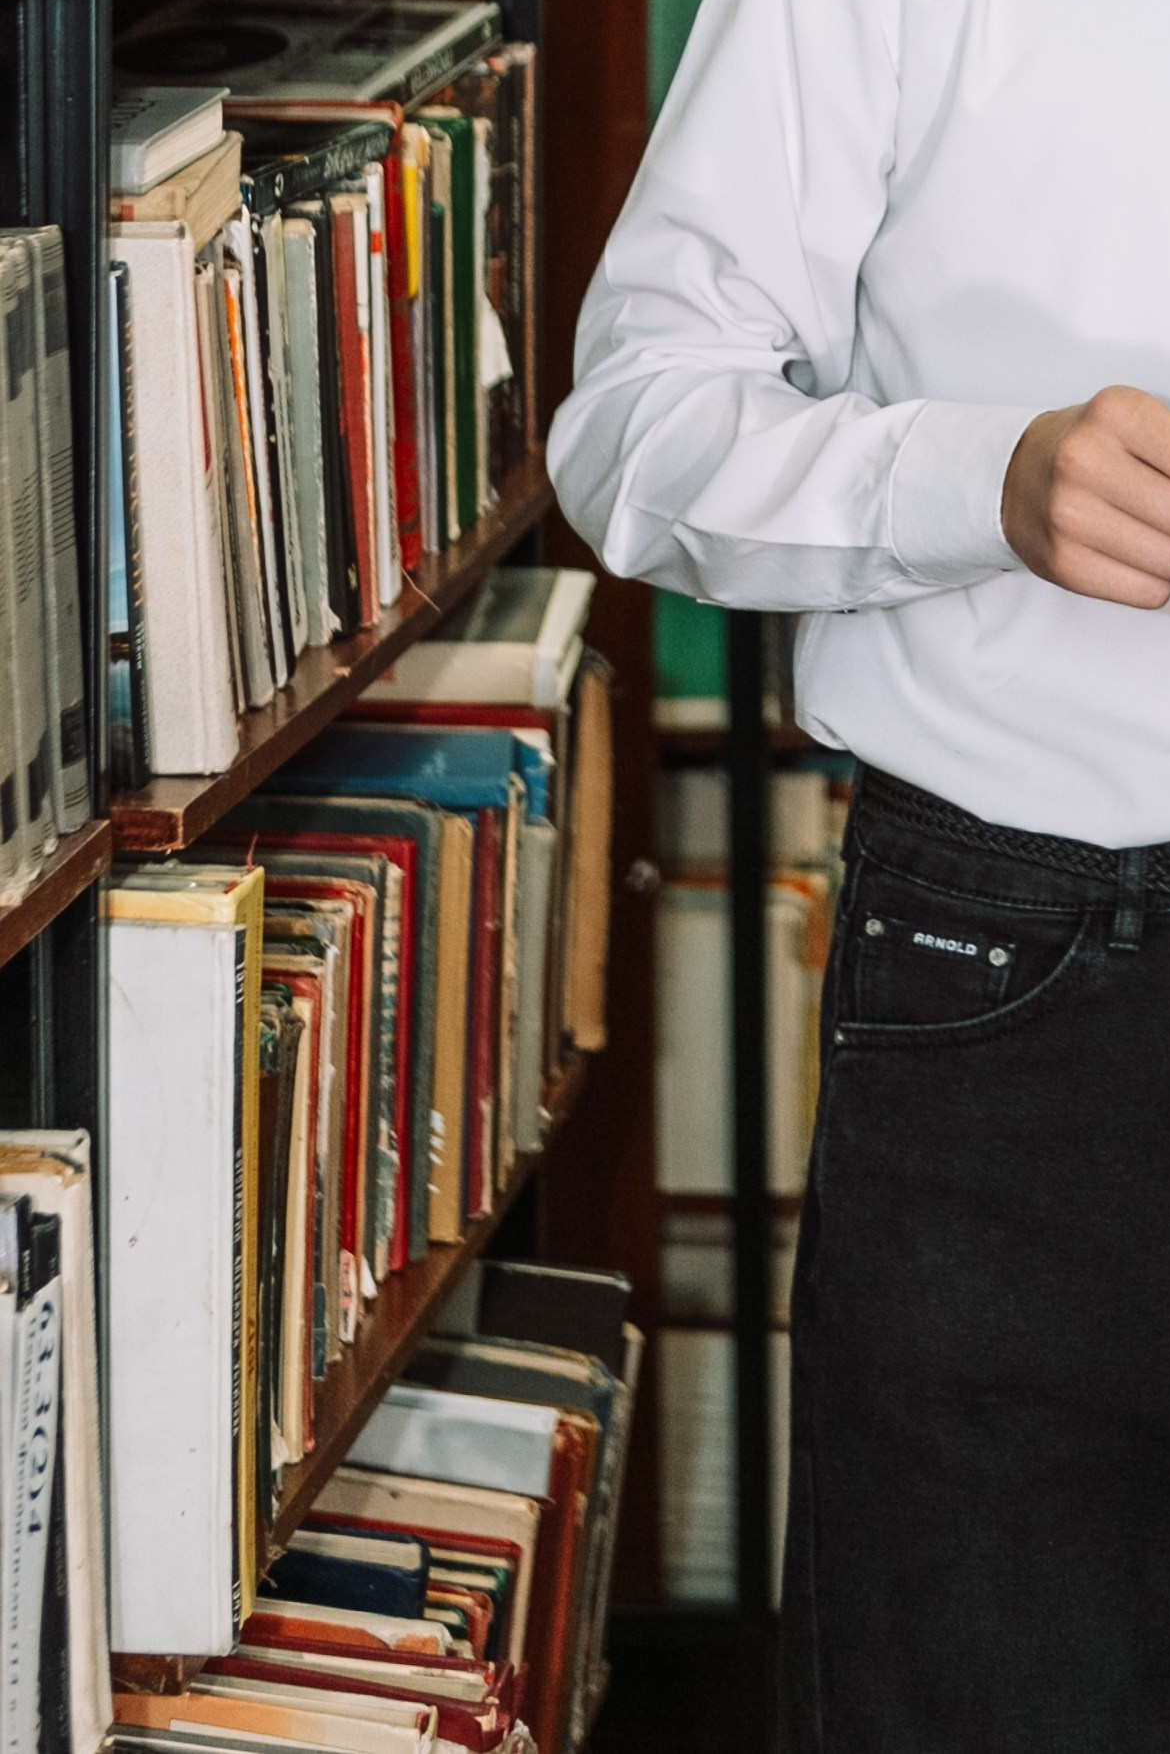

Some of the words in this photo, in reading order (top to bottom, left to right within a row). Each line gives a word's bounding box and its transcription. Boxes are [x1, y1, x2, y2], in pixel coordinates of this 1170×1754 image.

[128, 451, 146, 610] РОССИИ
[912, 932, 978, 957] ARNOLD
[21, 1317, 37, 1432] Период
[27, 1301, 56, 1535] 63.3(2)4
